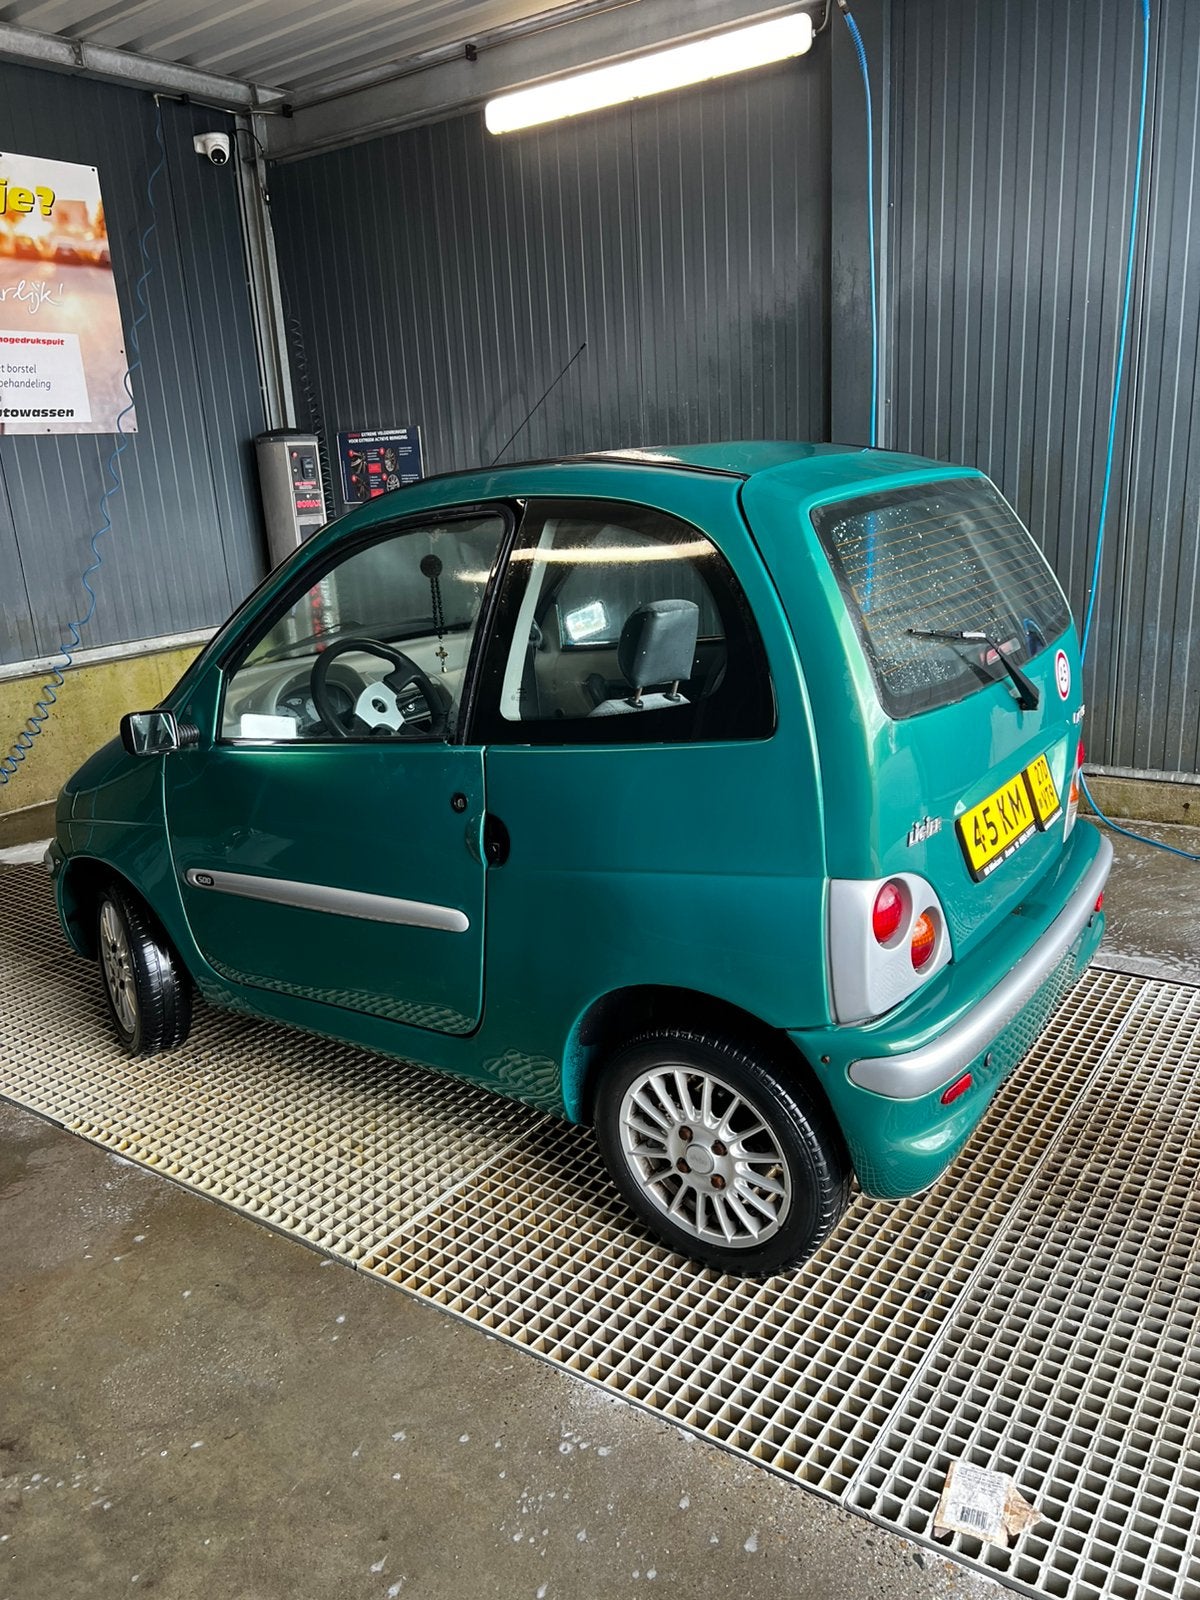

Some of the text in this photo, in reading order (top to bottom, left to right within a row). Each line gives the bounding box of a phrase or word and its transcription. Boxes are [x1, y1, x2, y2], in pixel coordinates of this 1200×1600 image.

[0, 279, 64, 314] rlijk!
[7, 363, 37, 374] borstel
[973, 806, 999, 853] 45
[996, 783, 1028, 836] KM
